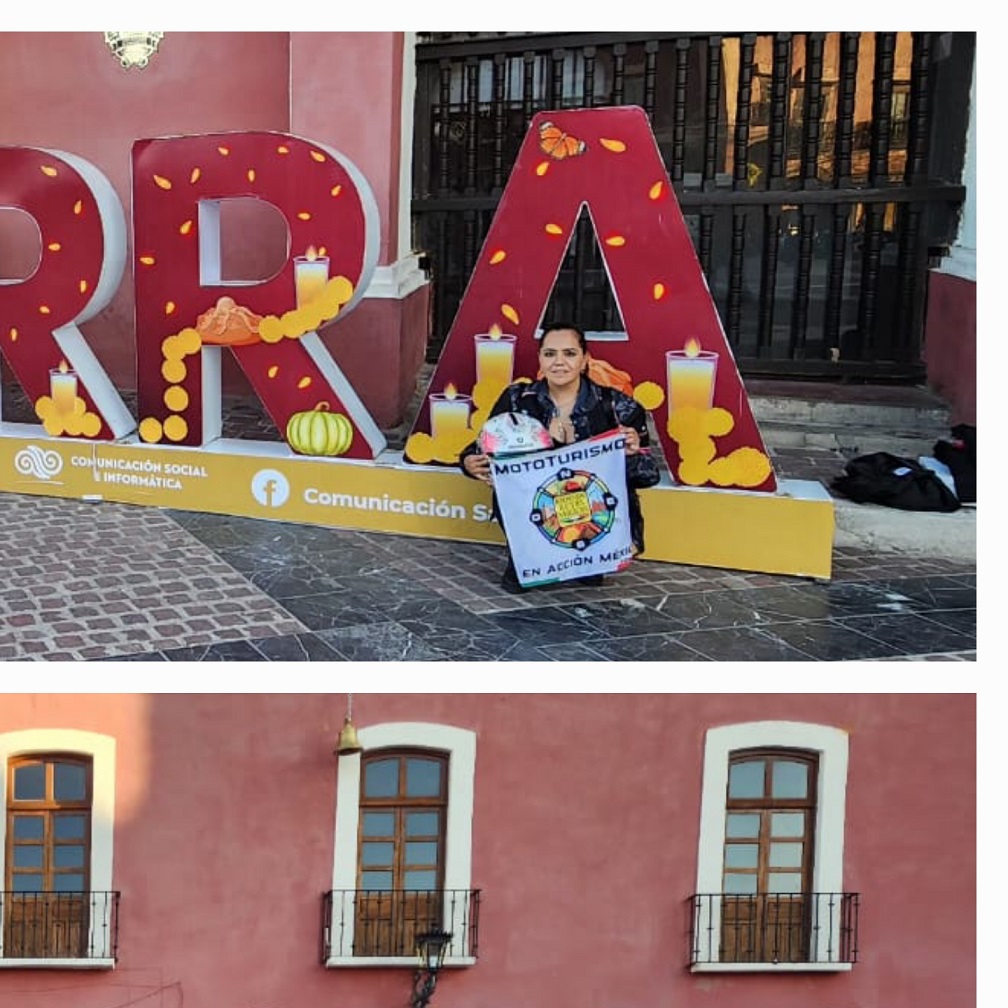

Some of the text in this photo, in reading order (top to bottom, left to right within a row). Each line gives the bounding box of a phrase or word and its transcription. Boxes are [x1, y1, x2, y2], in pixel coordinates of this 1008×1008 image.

[494, 438, 627, 476] MOTOTURISMO
[164, 463, 208, 478] SOCIAL
[304, 488, 466, 519] Comunicación
[522, 568, 541, 578] EN
